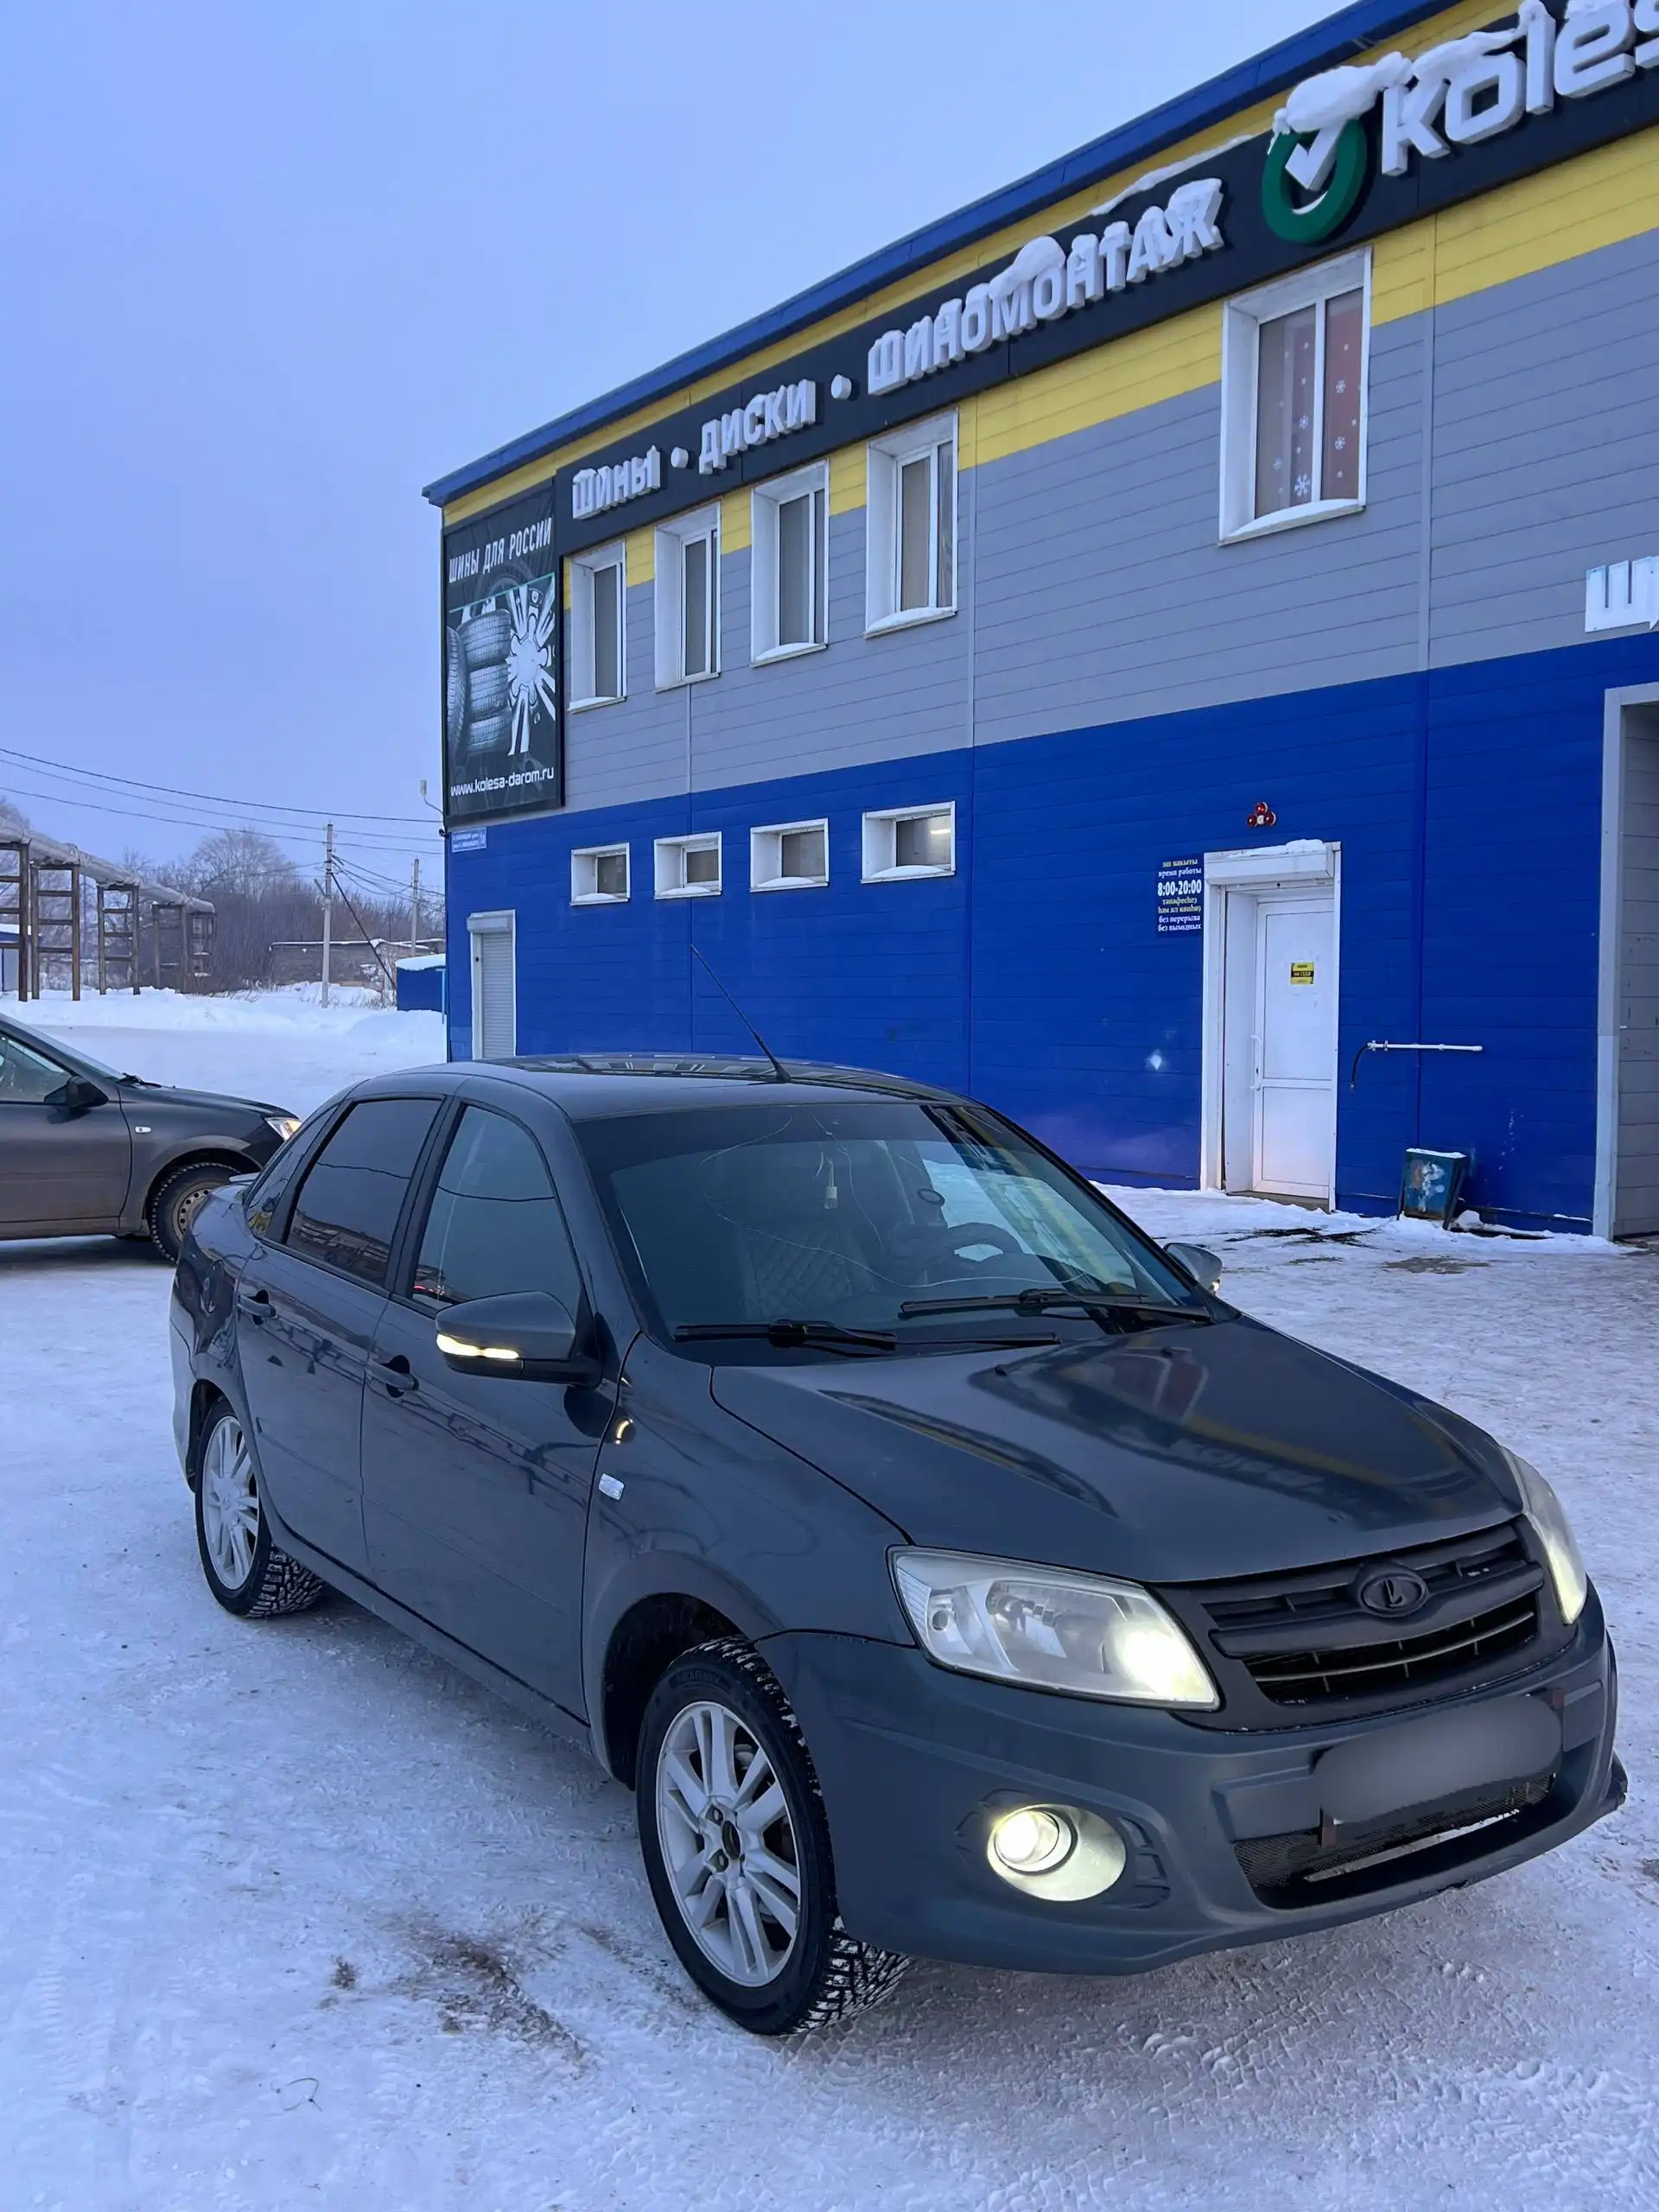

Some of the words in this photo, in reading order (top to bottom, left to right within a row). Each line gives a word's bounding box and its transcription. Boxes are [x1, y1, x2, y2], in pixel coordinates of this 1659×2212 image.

[572, 446, 660, 518] ШИНЫ
[699, 379, 816, 474] ДИСКИ
[868, 179, 1224, 396] ШИНОМОНТАЖ
[449, 549, 480, 583] ШИНЫ
[483, 538, 505, 574] ДЛЯ
[509, 518, 551, 560] РОССИИ
[450, 767, 554, 796] www.kolesa-darom.ru
[1178, 868, 1202, 878] работы
[1158, 880, 1202, 896] 8:00-20:00
